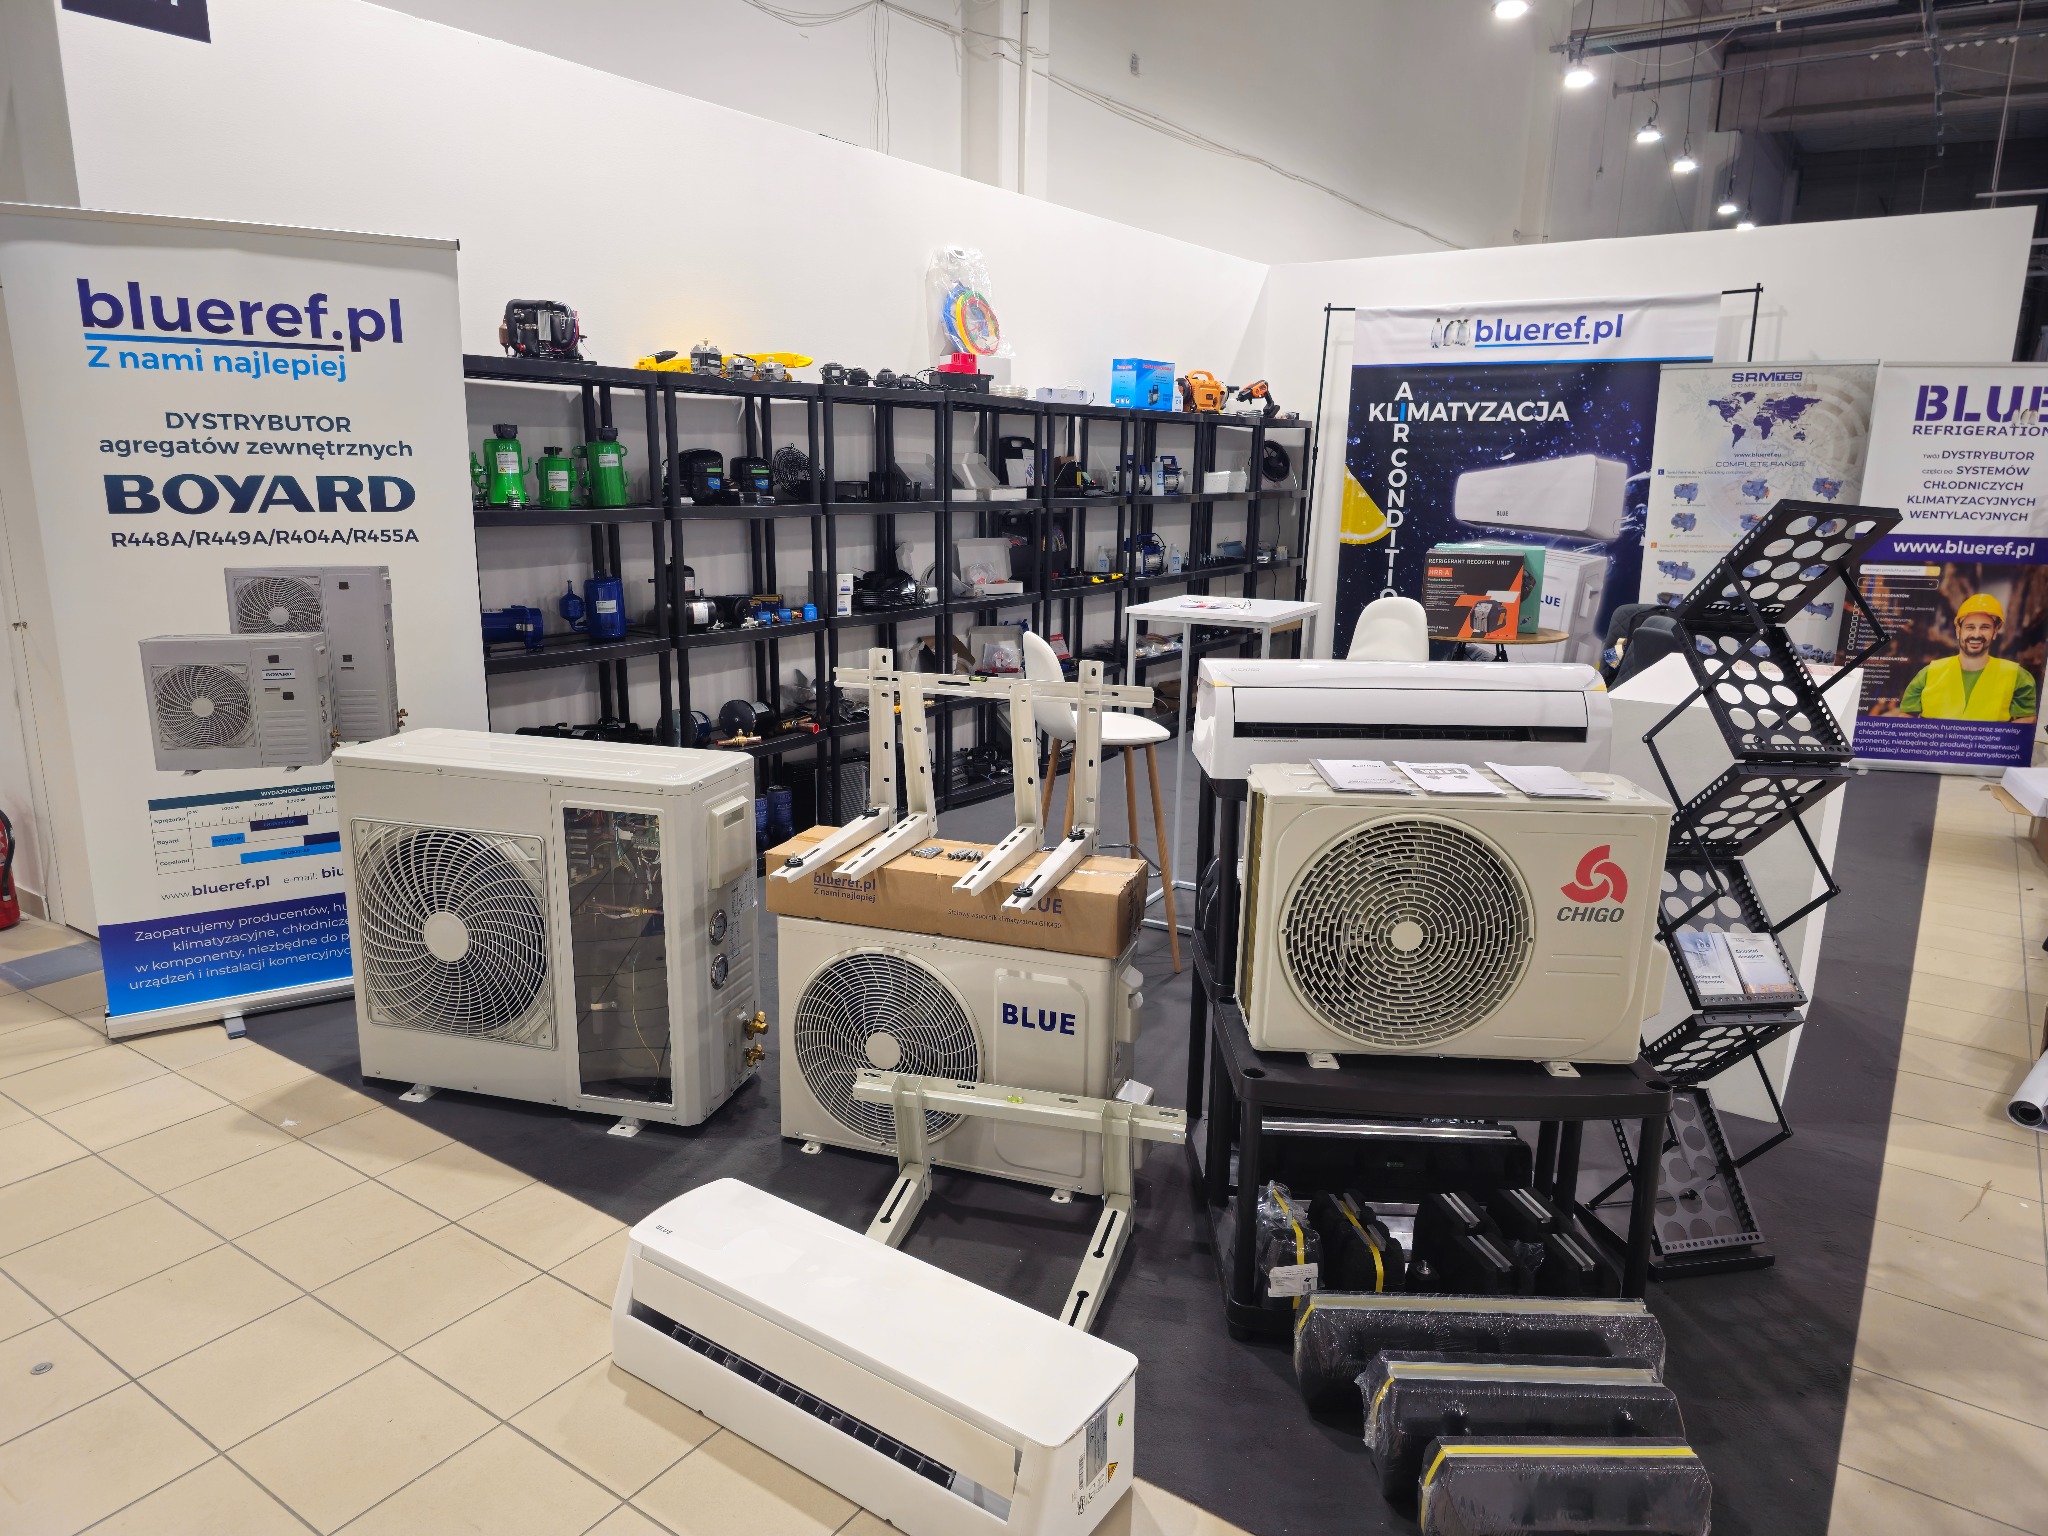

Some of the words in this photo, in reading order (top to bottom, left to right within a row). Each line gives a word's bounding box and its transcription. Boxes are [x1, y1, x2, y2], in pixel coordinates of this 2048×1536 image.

[76, 277, 403, 352] blueref.pl
[1474, 314, 1624, 345] blueref.pl
[87, 345, 110, 368] Z
[119, 348, 203, 372] nami
[214, 352, 347, 382] najlepiej
[1368, 401, 1569, 422] KLIMATYZACJA
[1914, 385, 2048, 423] BLUE
[165, 412, 351, 432] DYSTRYBUTOR
[99, 436, 239, 458] agregatów
[246, 439, 413, 459] zewnętrznych
[1941, 450, 2035, 460] DYSTRYBUTOR
[1956, 465, 2030, 476] SYSTEMÓW
[104, 474, 416, 515] BOYARD
[1923, 480, 2024, 491] CHŁODNICZYCH
[1906, 495, 2036, 507] KLIMATYZACYJNYCH
[1909, 510, 2028, 521] WENTYLACYJNYCH
[111, 529, 419, 548] R448A/R449A/R404A/R455A
[1893, 540, 2035, 559] www.blueref.pl
[1540, 594, 1561, 607] UE
[1891, 722, 1940, 731] producentów,
[1941, 724, 1977, 732] hurtownie
[1994, 726, 2021, 735] serwisy
[1899, 731, 1944, 739] wentylacyjne
[1948, 732, 2001, 742] klimatyzacyjne
[1869, 746, 1899, 754] instalacji
[1900, 748, 1949, 756] komercyjnych
[1891, 739, 1929, 748] niezbędne
[1940, 741, 1974, 750] produkcji
[1978, 743, 2020, 751] konserwacji
[161, 876, 271, 901] www.blueref.pl
[283, 872, 318, 884] e-mail:
[814, 872, 876, 892] blueref.pl
[814, 887, 819, 895] Z
[820, 889, 840, 898] nami
[134, 919, 235, 942] Zaopatrujemy
[239, 905, 331, 928] producentów,
[1556, 906, 1625, 923] CHIGO
[173, 927, 279, 952] klimatyzacyjne,
[134, 964, 148, 974] w
[152, 949, 245, 972] komponenty,
[248, 938, 318, 956] niezbędne
[321, 933, 338, 945] do
[129, 971, 195, 990] urządzeń
[206, 960, 266, 978] instalacji
[1003, 1002, 1076, 1036] BLUE
